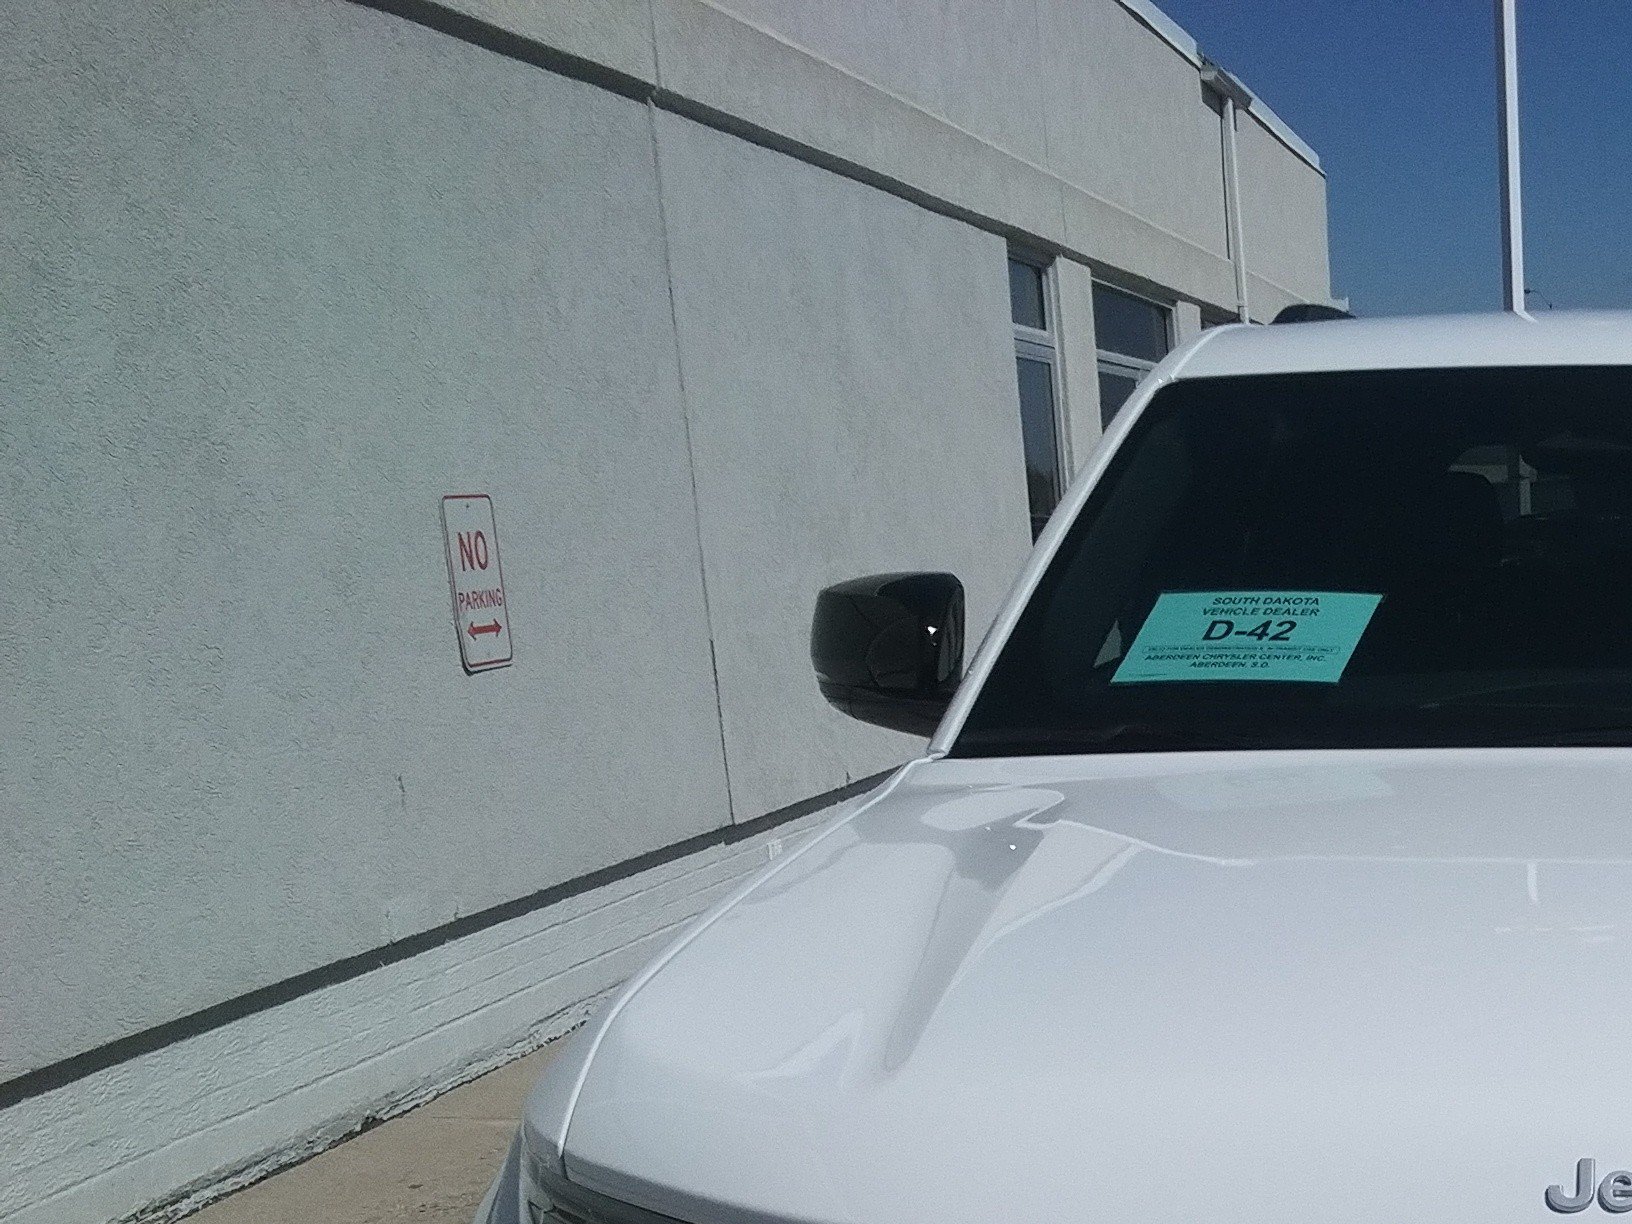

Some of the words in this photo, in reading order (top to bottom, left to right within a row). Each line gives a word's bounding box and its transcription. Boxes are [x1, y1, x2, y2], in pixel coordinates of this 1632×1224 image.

[457, 530, 489, 571] NO
[458, 588, 502, 611] PARKING
[1212, 597, 1261, 605] SOUTH
[1262, 597, 1320, 605] DAKOTA
[1202, 607, 1261, 616] VEHICLE
[1262, 607, 1320, 616] DEALER
[1202, 619, 1297, 641] D-42
